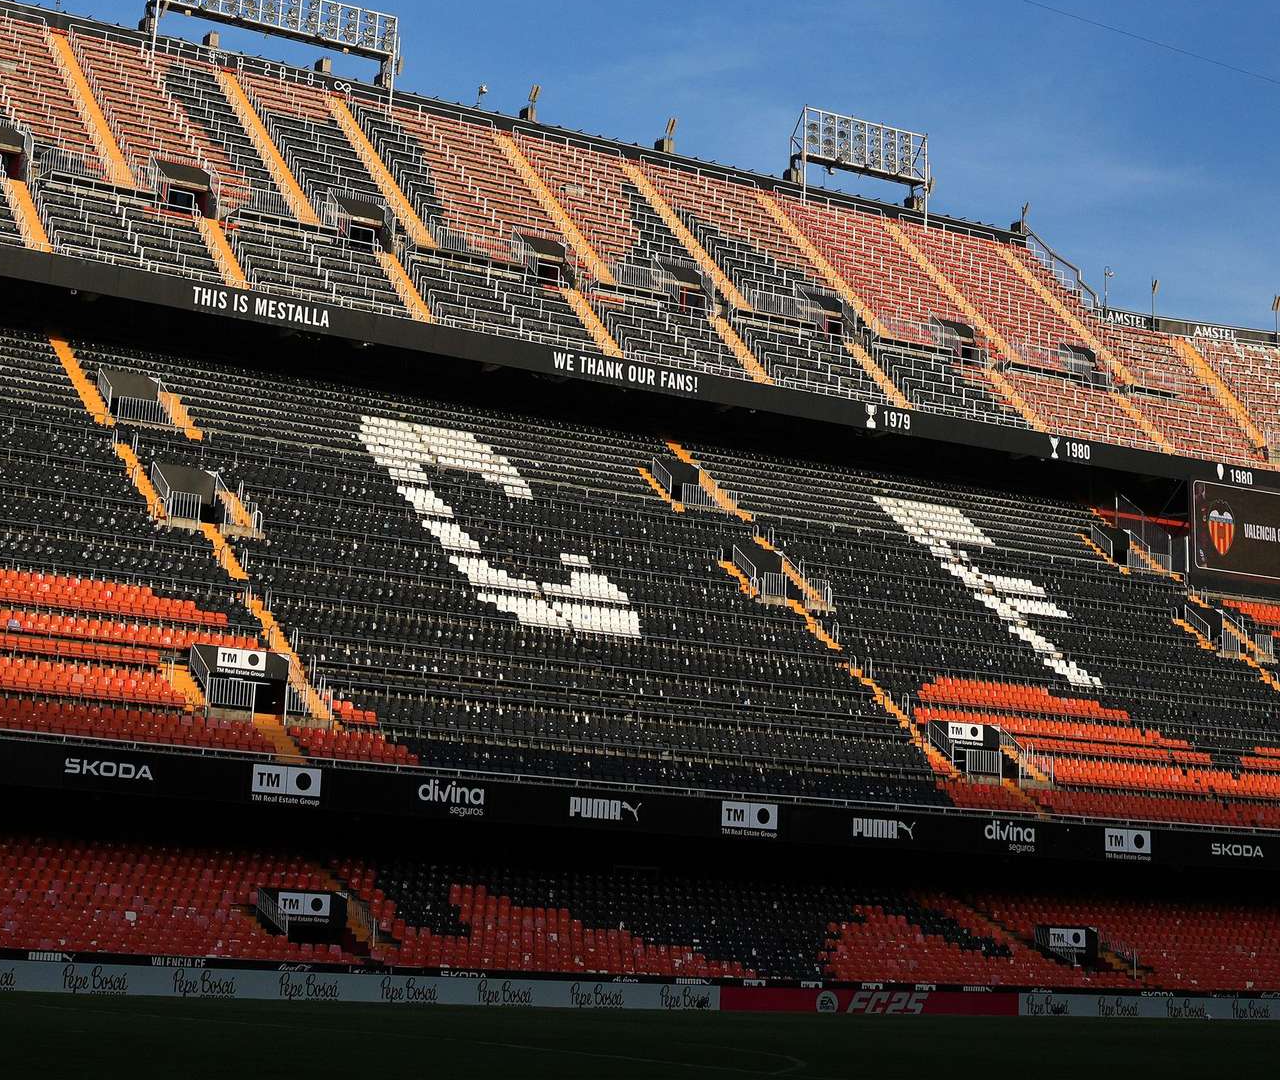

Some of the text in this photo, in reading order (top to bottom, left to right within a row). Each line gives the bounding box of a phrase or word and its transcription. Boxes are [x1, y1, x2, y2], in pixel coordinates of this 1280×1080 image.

[192, 286, 329, 328] THIS IS MESTALLA
[1107, 310, 1147, 329] AMSTEL
[1193, 325, 1237, 341] AMSTEL
[553, 350, 698, 394] WE THANK OUR FANS!
[882, 410, 911, 431] 1979
[1065, 441, 1090, 461] 1980
[1230, 469, 1253, 485] 1980
[1244, 522, 1276, 543] VALENCIA
[221, 652, 237, 664] TM
[951, 726, 963, 736] TM
[258, 772, 281, 788] TM
[263, 794, 277, 803] Real
[278, 796, 299, 804] Estate
[299, 797, 320, 807] Group
[418, 778, 485, 806] divina
[449, 805, 484, 817] seguros
[569, 796, 624, 821] PUMA
[725, 808, 745, 822] TM
[730, 828, 741, 836] Real
[743, 829, 759, 837] Estate
[760, 831, 778, 840] Group
[853, 817, 898, 839] PUMA
[984, 820, 1036, 843] divina
[1008, 842, 1036, 853] seguros
[1108, 834, 1124, 846] TM
[282, 898, 299, 910] TM
[62, 963, 128, 996] Pepe Boscá
[172, 968, 237, 997] Pepe Boscá
[279, 972, 339, 1000] Pepe Boscá
[379, 976, 439, 1003] Pepe Boscá
[477, 979, 533, 1006] Pepe Boscá
[569, 983, 625, 1007] Pepe Boscá
